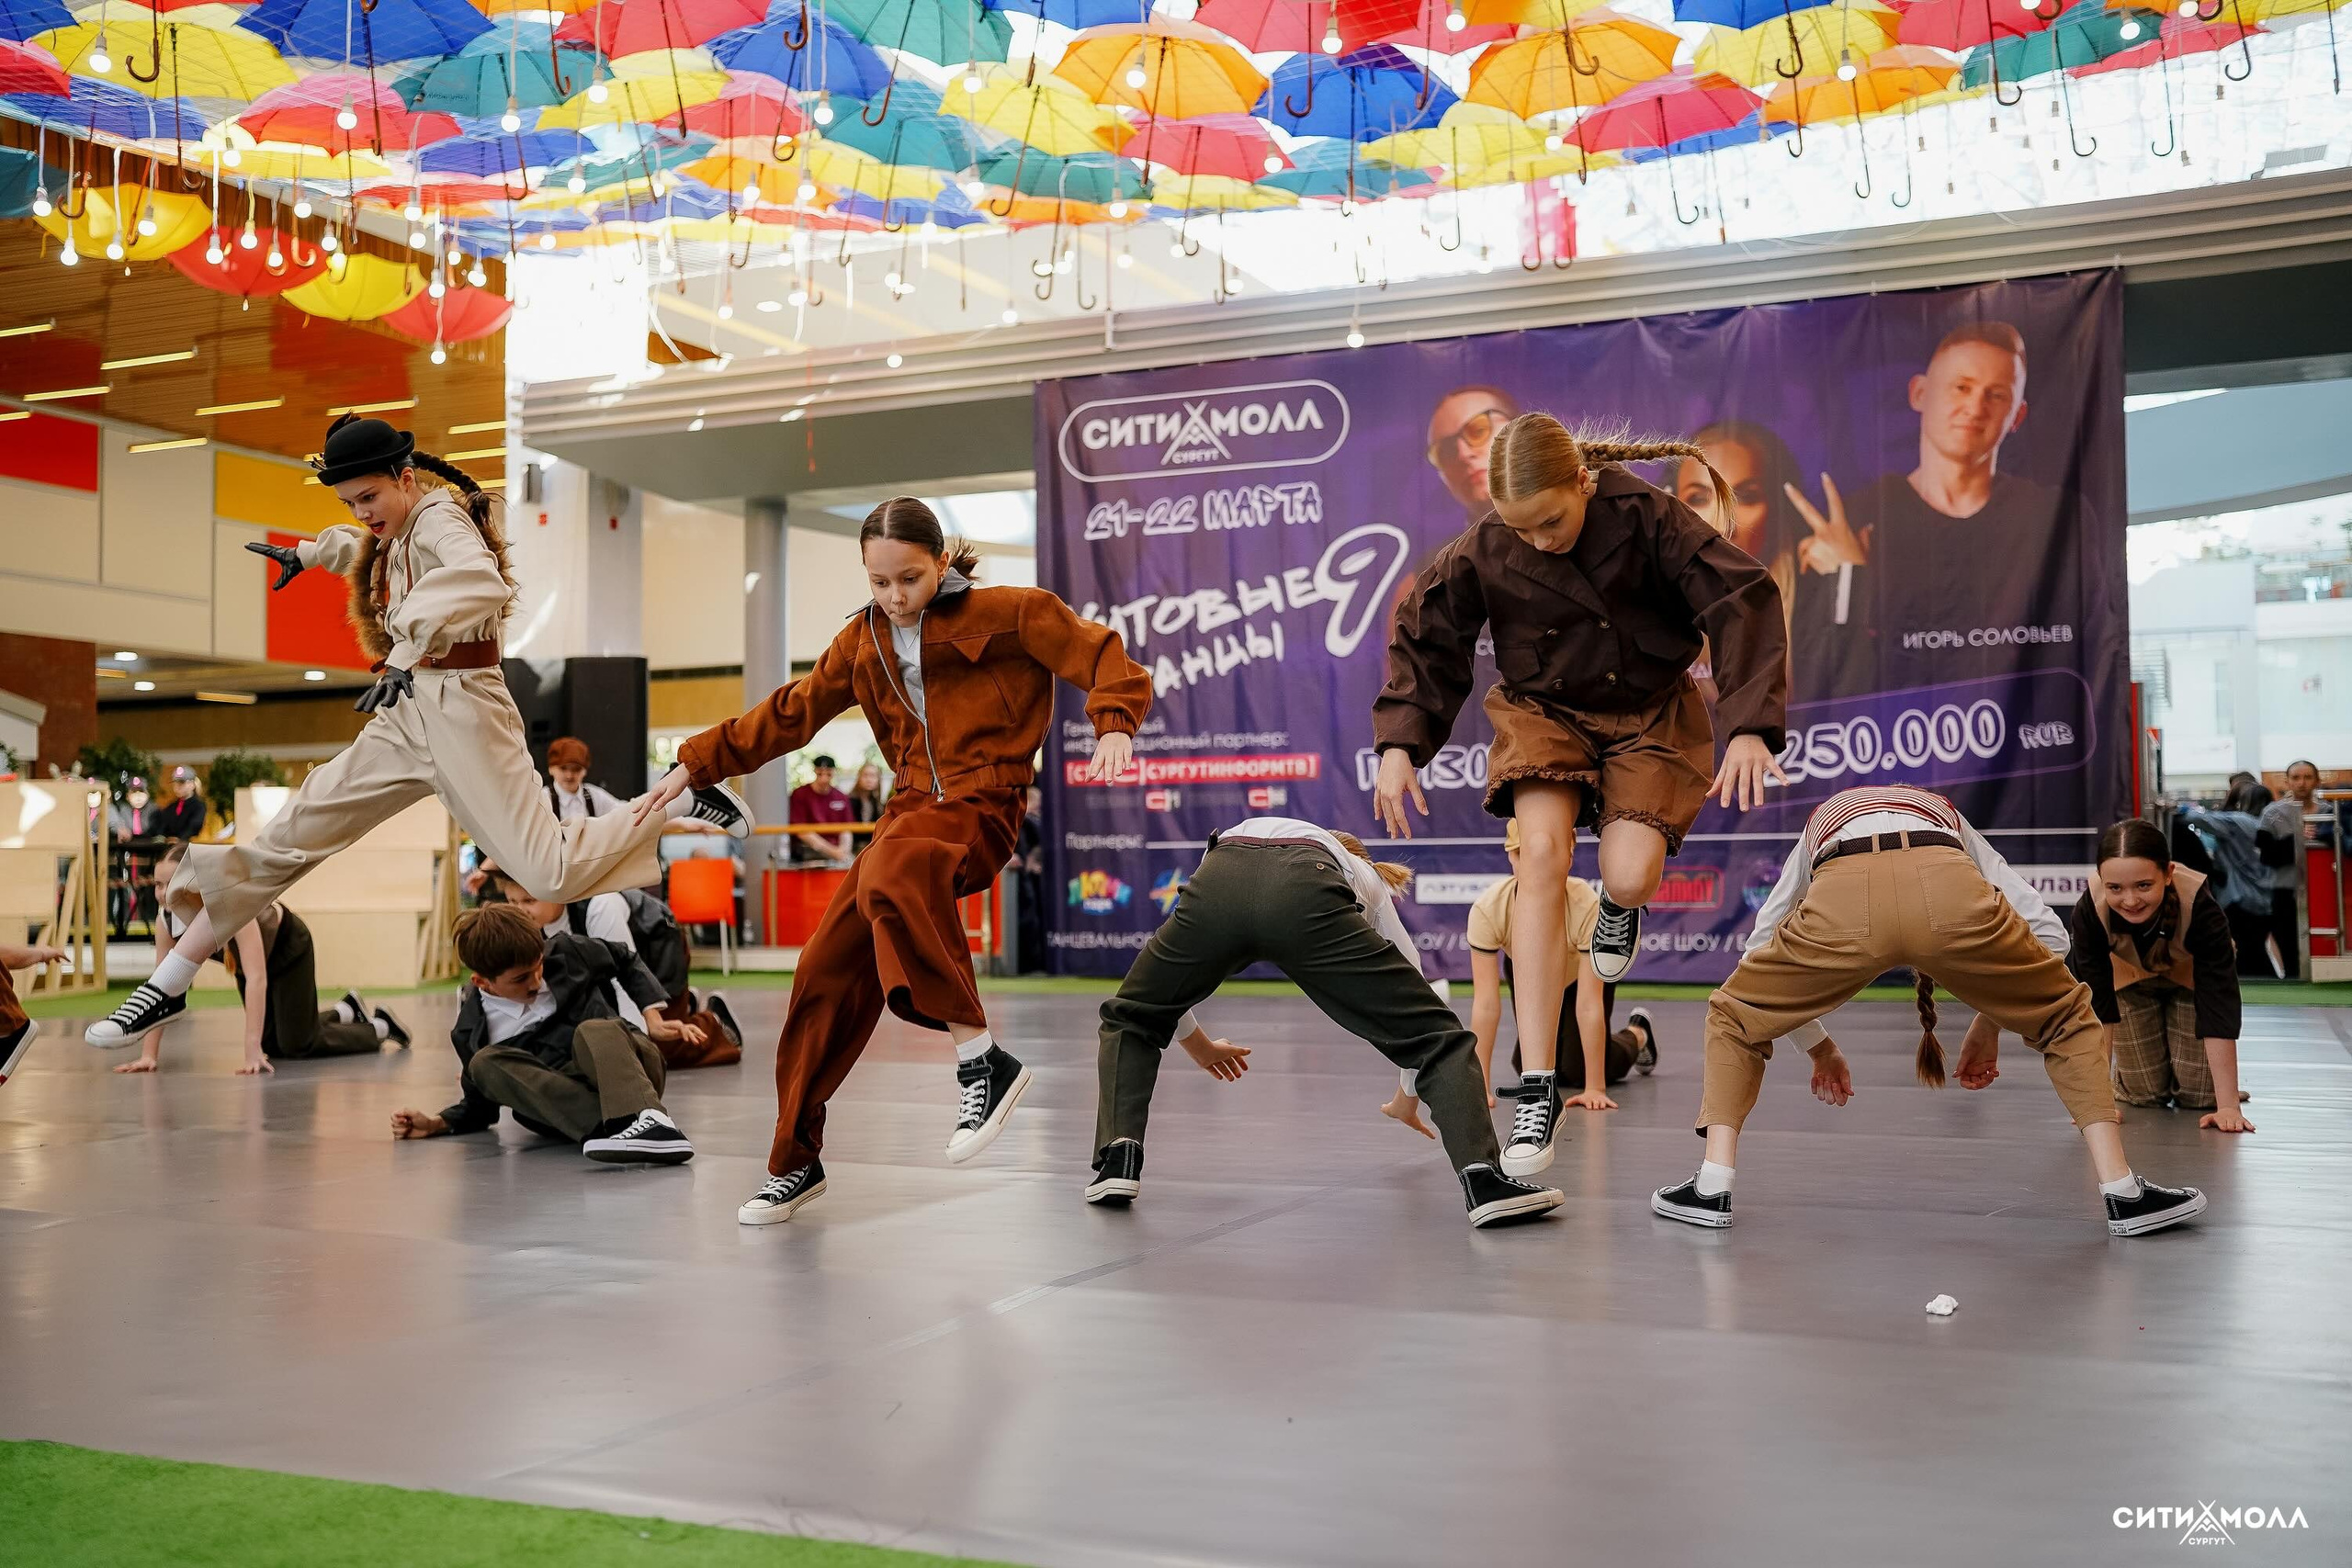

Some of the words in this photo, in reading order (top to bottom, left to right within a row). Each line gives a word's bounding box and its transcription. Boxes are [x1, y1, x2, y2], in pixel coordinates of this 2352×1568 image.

[1083, 494, 1199, 540] 21-22
[1202, 480, 1324, 531] МАРТА
[1903, 631, 1965, 649] ИГОРЬ
[1968, 624, 2074, 647] СОЛОВЬЕВ
[1143, 620, 1284, 699] АНЦЫ
[2018, 720, 2075, 750] RUB
